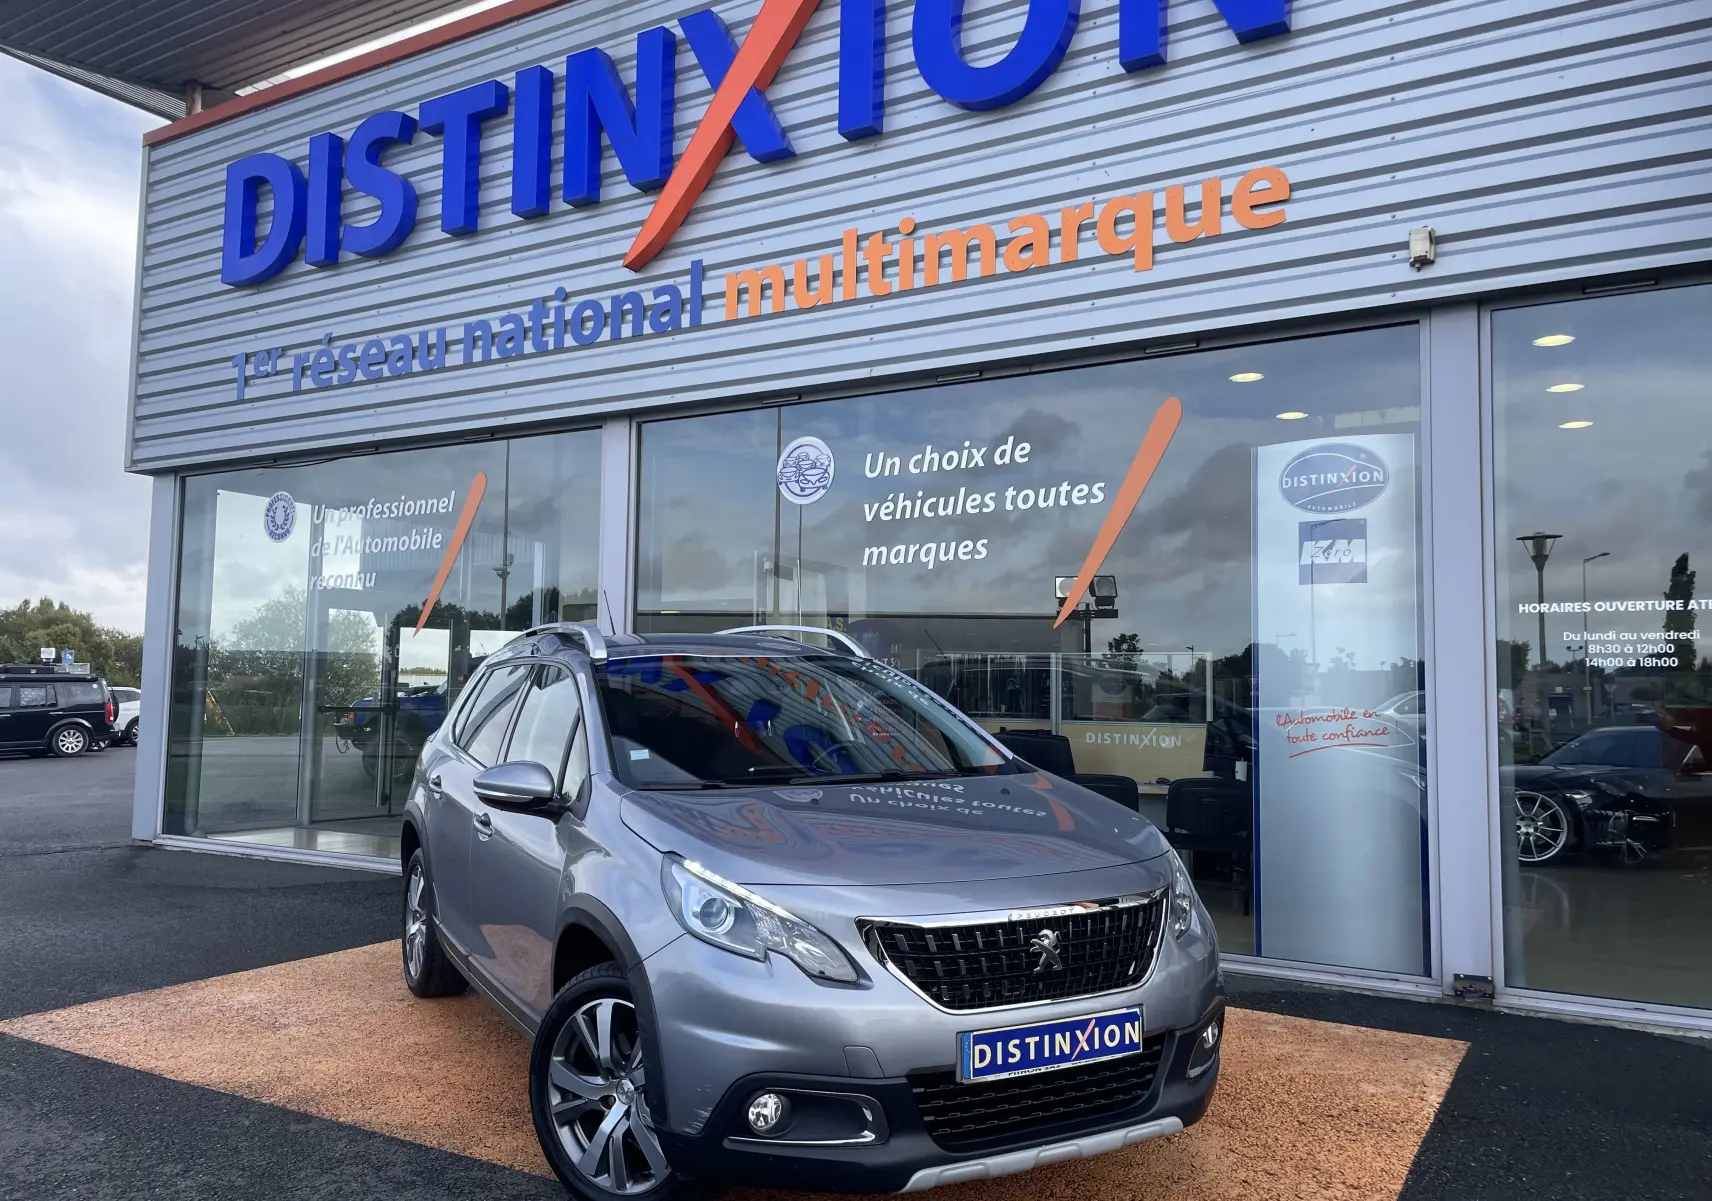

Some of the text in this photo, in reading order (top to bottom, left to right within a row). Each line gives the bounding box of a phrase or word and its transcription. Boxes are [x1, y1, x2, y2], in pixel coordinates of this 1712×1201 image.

[231, 166, 1290, 400] 1er réseau national multimarque
[864, 436, 1032, 479] Un choix de
[1282, 464, 1384, 490] DISTINXION
[313, 490, 457, 528] Un professionnel
[863, 479, 1106, 523] véhicules toutes
[311, 527, 444, 558] de l'Automobile
[1310, 545, 1352, 559] Zero
[862, 538, 989, 570] marques
[310, 571, 377, 591] reconnu
[1518, 601, 1592, 614] HORAIRES
[1593, 600, 1684, 613] OUVERTURE
[1563, 629, 1701, 641] Du lundi au vendredi
[1588, 643, 1675, 654] 8h30 à 12h00
[1585, 657, 1679, 667] 14h00 à 18h00
[1363, 709, 1380, 719] en
[1085, 727, 1182, 750] DISTINXION
[1286, 727, 1318, 744] toute
[1322, 723, 1391, 742] confiance
[1016, 908, 1075, 920] PEUGEOT
[973, 1018, 1141, 1069] DISTINXION
